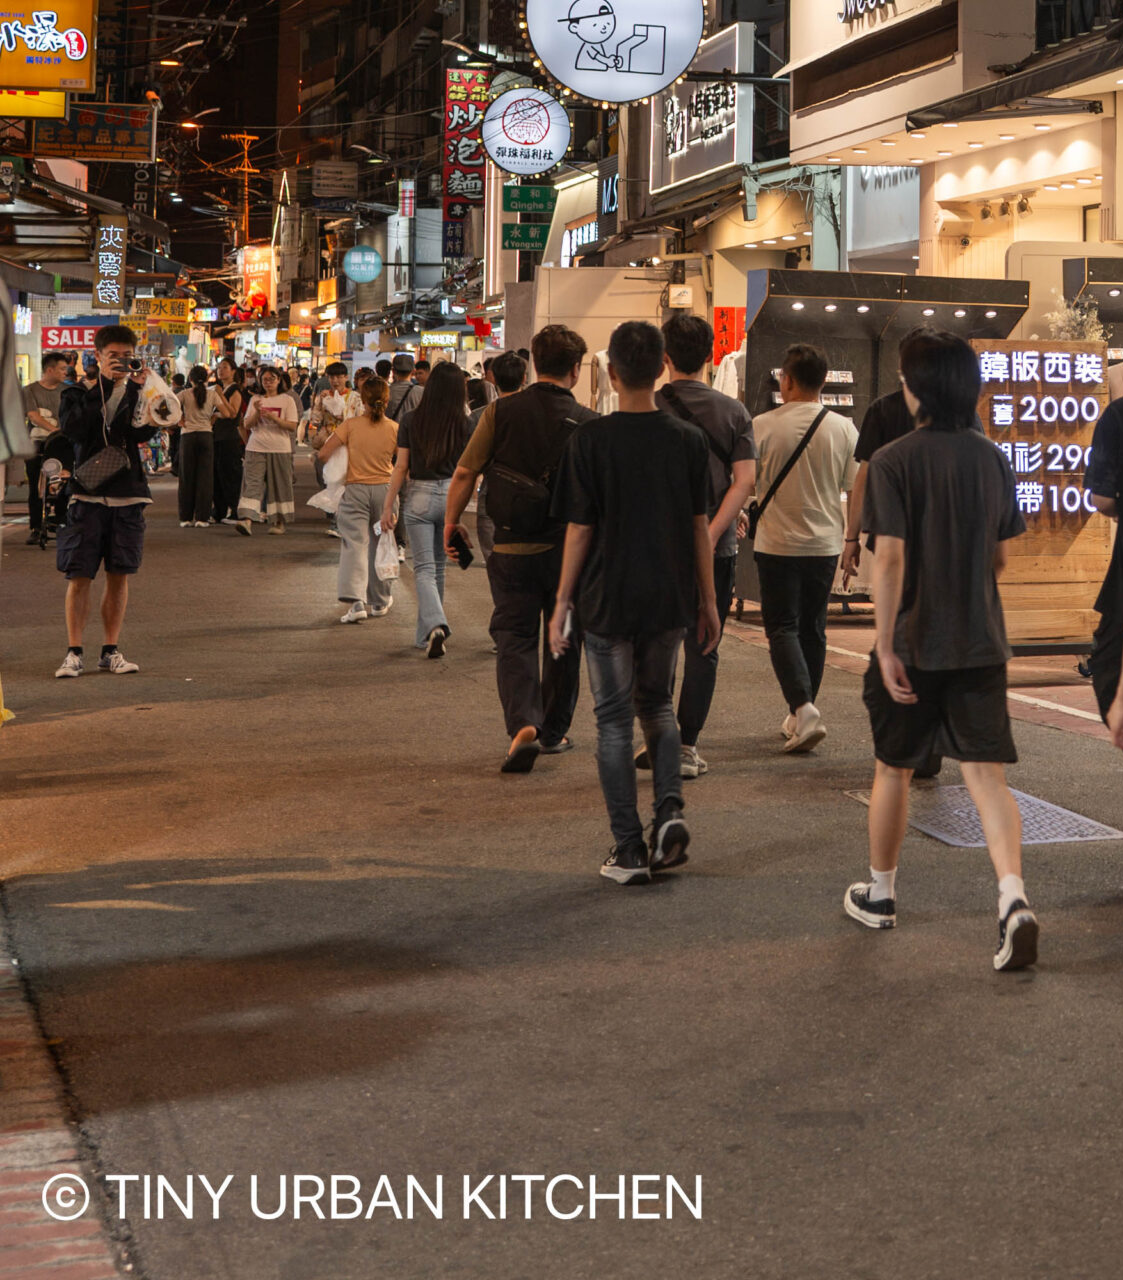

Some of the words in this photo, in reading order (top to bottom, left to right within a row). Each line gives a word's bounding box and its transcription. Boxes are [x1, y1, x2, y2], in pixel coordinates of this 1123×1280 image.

[447, 103, 485, 199] 炒泡麵
[495, 147, 554, 160] 彈珠福利社
[510, 201, 544, 210] Qinghe
[510, 227, 541, 238] 永新
[510, 241, 542, 250] Yongxin
[135, 300, 186, 316] 鹽水雞
[47, 329, 95, 346] SALE
[980, 351, 1103, 383] 韓版西裝
[1020, 396, 1099, 422] 2000
